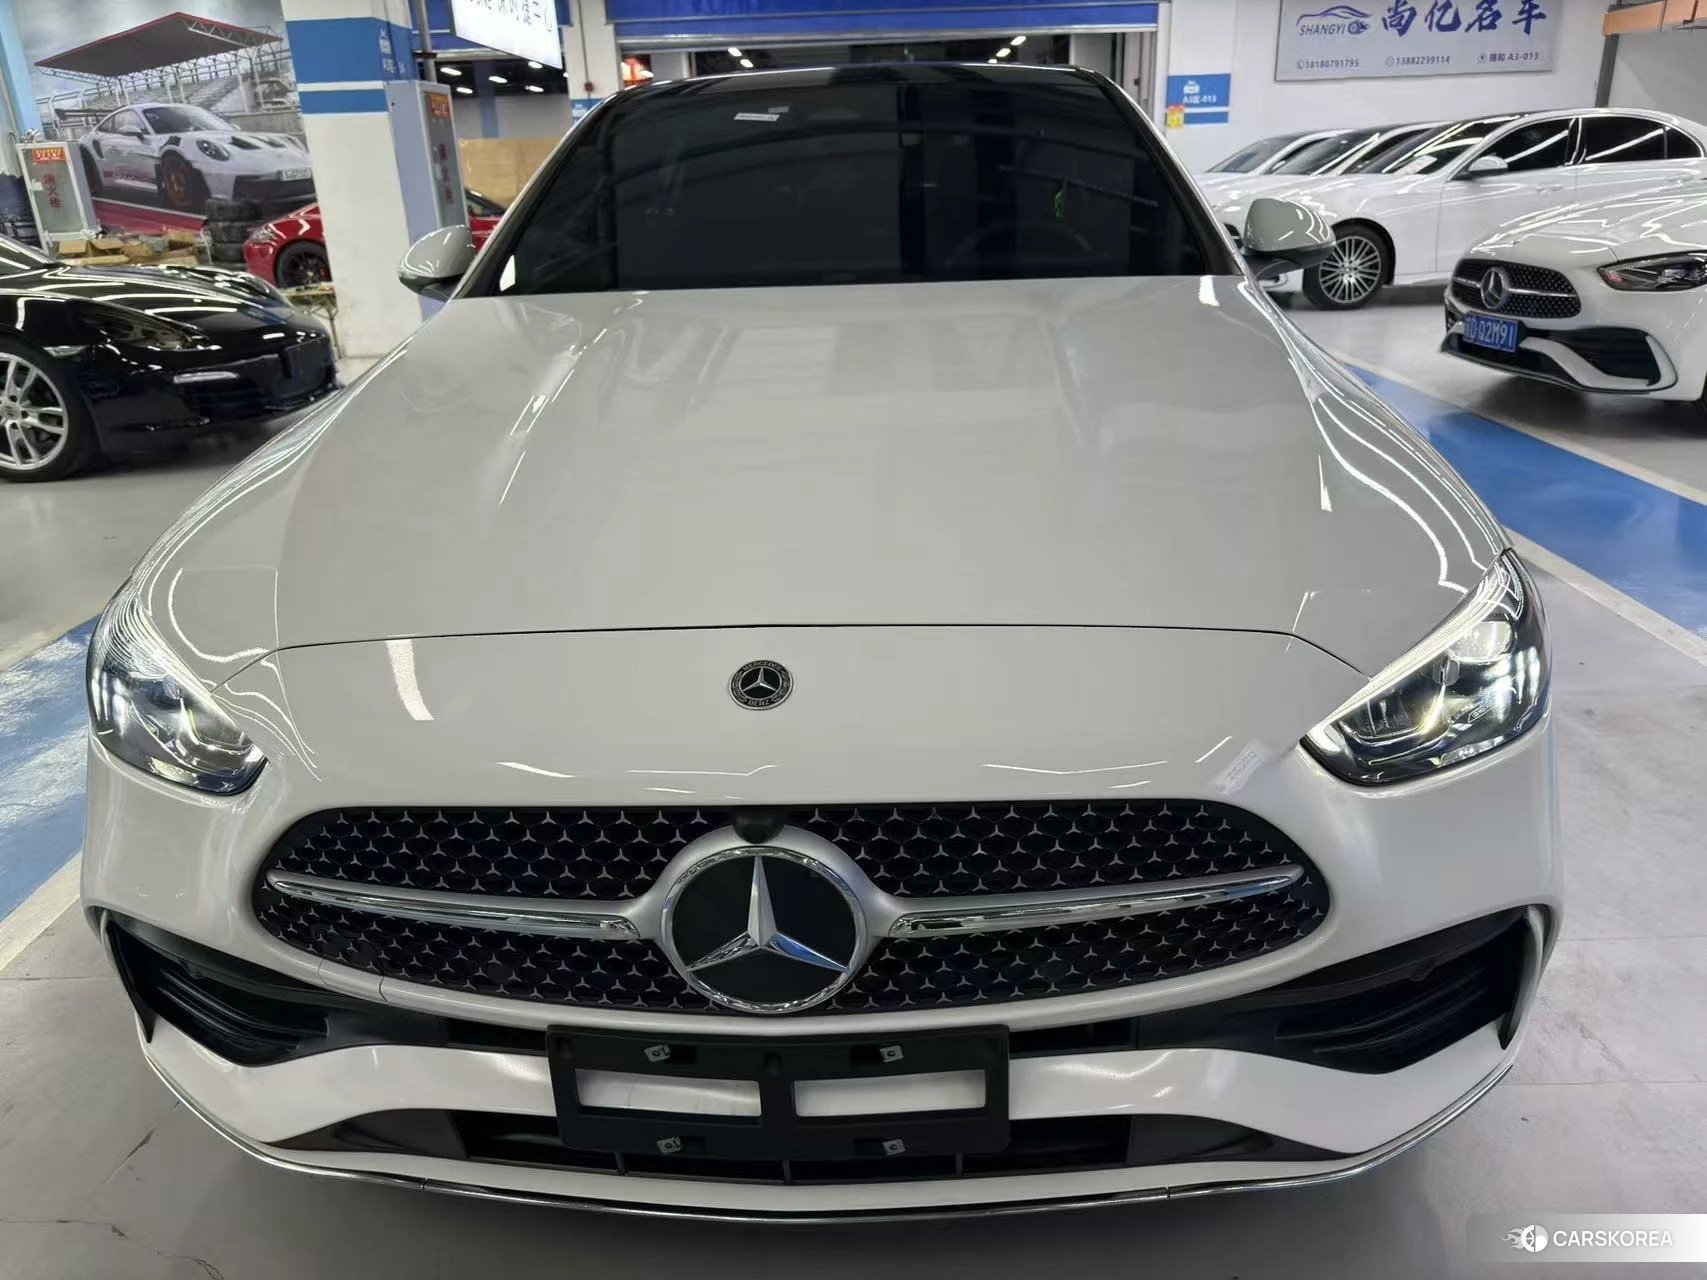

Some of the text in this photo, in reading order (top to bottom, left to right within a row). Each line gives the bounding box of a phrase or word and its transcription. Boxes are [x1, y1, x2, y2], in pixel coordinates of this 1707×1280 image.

[1381, 0, 1547, 37] 尚亿名车
[1298, 23, 1346, 36] SHANGYI
[1396, 55, 1451, 66] 13882239114
[1507, 51, 1539, 61] A3-013
